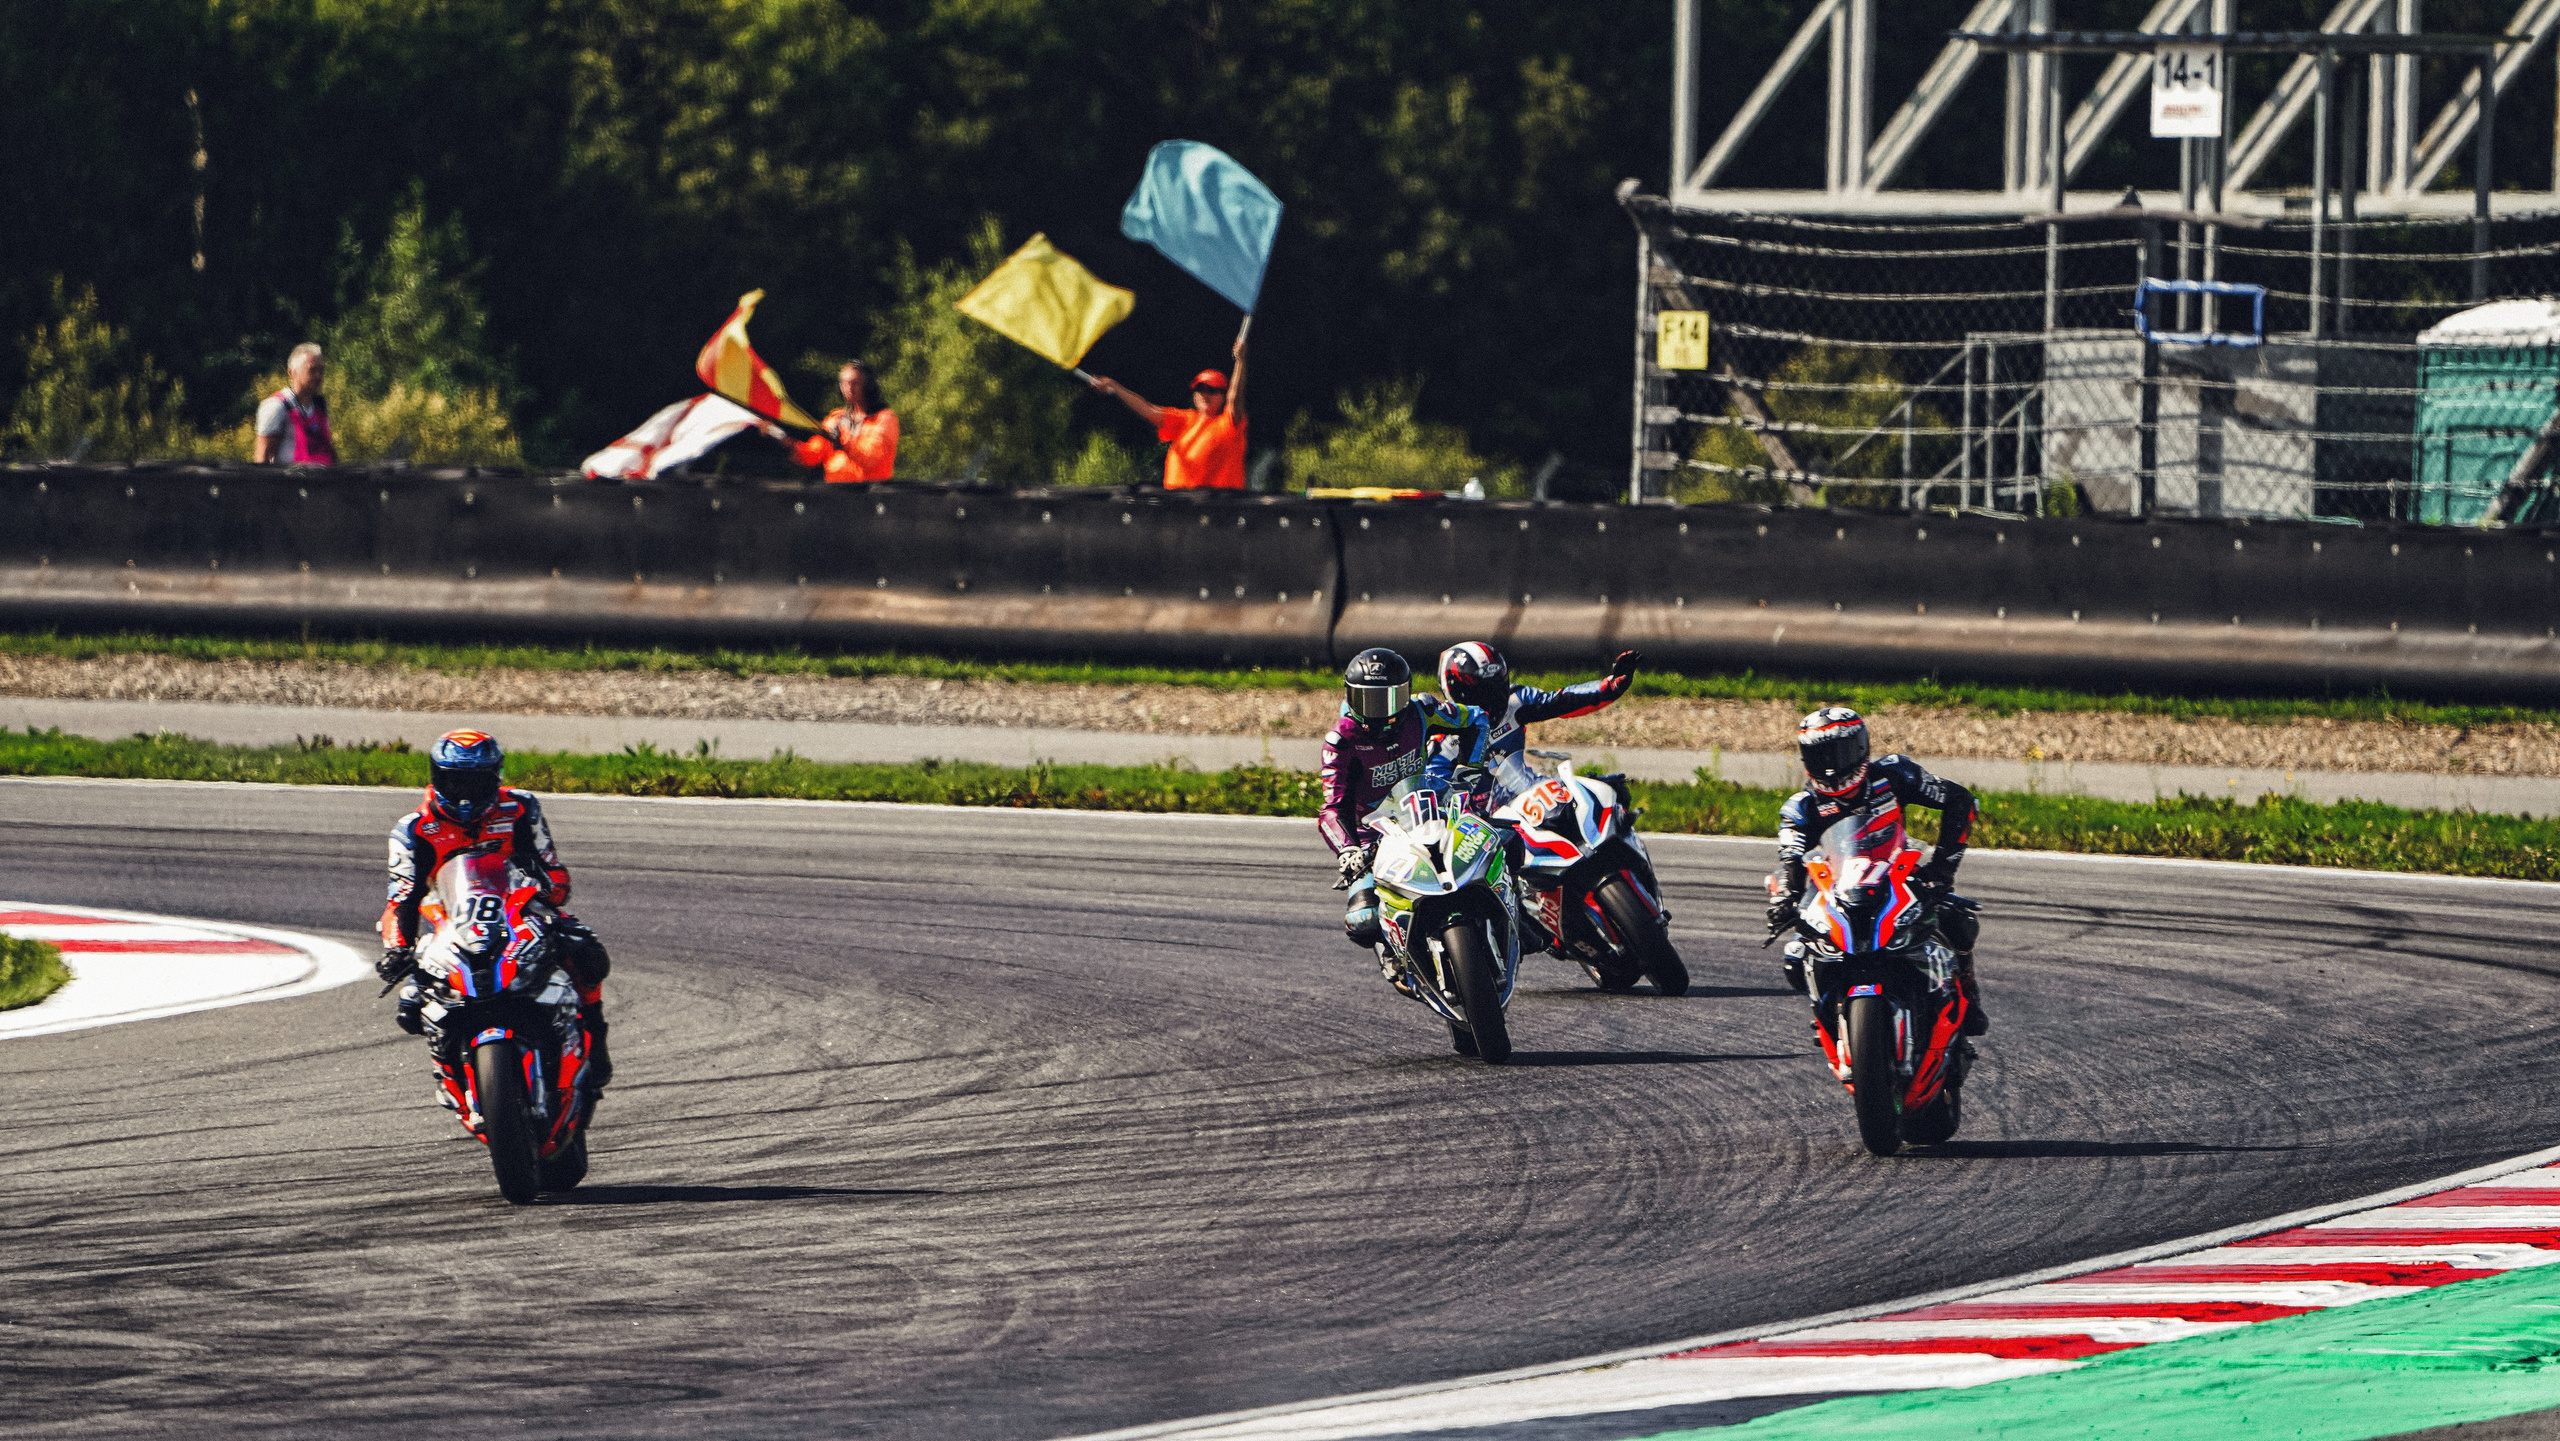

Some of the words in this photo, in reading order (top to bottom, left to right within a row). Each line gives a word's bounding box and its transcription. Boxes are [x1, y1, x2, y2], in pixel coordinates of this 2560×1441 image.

[2161, 52, 2216, 88] 14-1
[1371, 749, 1416, 778] MULTI
[1371, 757, 1424, 788] MOTOR
